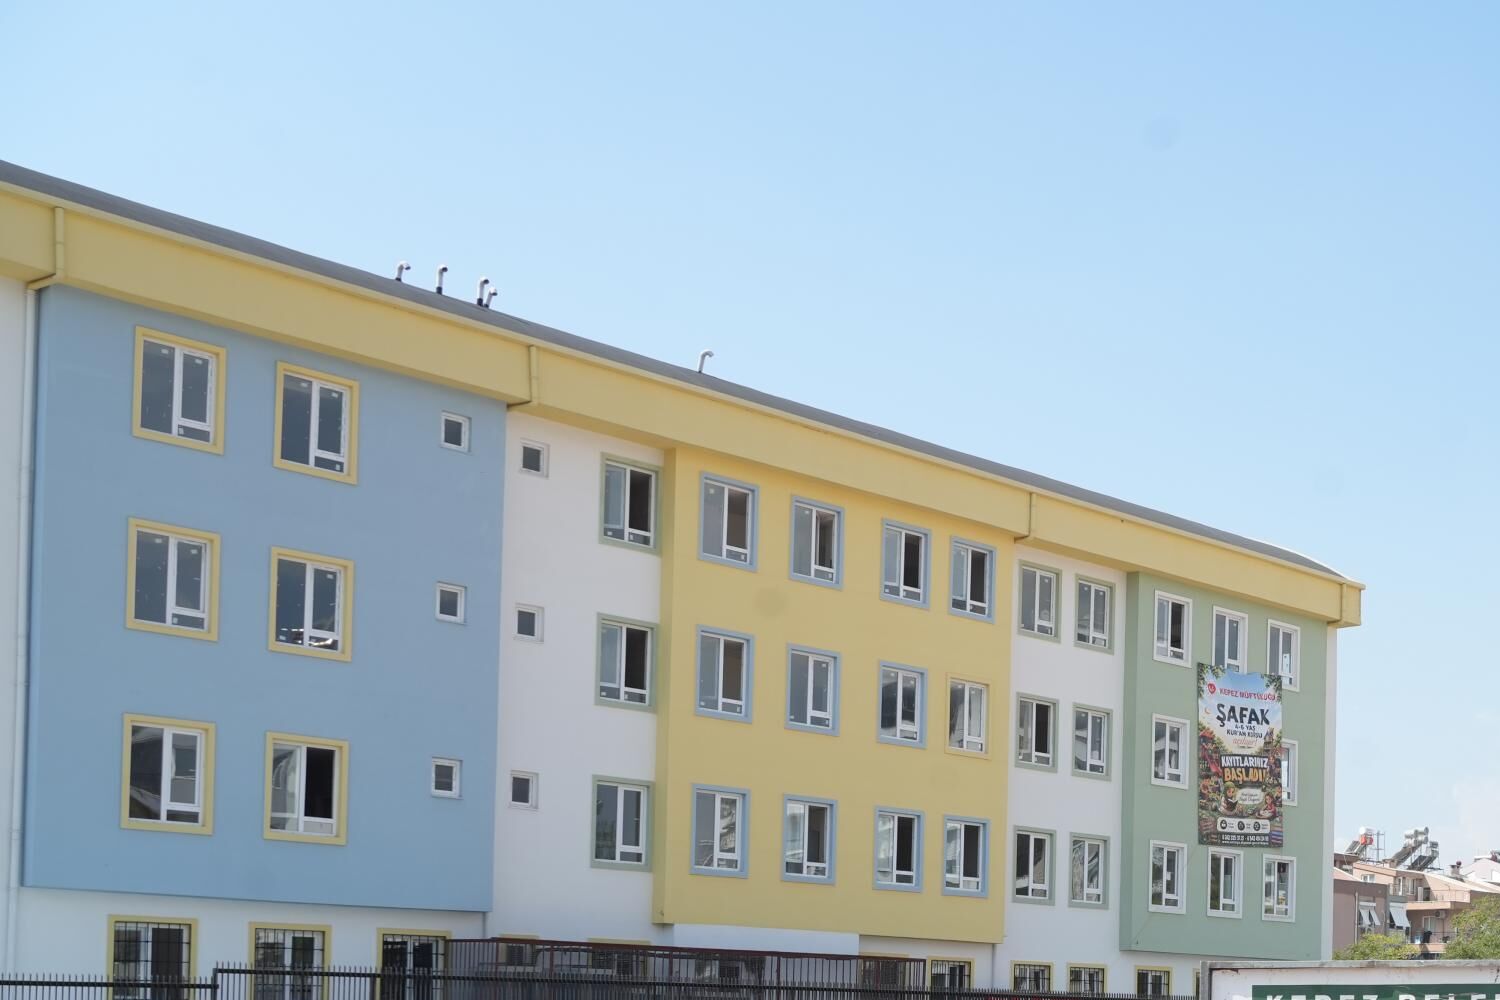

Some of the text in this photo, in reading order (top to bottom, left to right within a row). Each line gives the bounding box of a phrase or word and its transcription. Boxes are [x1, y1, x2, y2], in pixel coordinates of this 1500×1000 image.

[1220, 688, 1238, 697] KEPEZ
[1216, 703, 1270, 727] ŞAFAK
[1221, 756, 1268, 768] KAYITLARINIZ
